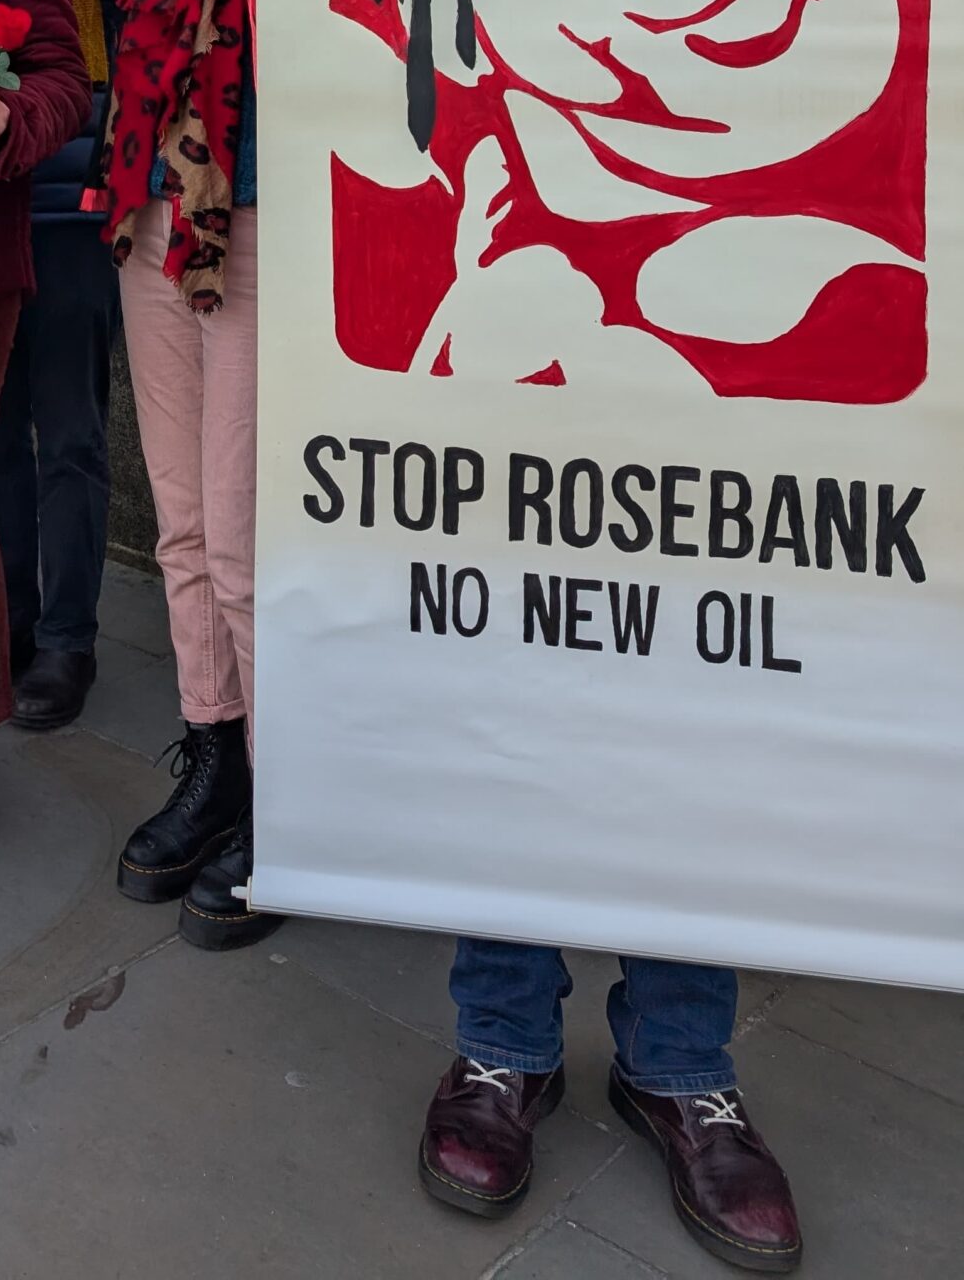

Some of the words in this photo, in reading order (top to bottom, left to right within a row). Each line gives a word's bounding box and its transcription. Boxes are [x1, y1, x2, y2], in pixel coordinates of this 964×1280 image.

[303, 434, 485, 536] STOP
[508, 452, 927, 584] ROSEBANK
[409, 561, 490, 638] NO
[523, 572, 660, 656] NEW
[696, 589, 802, 674] OIL
